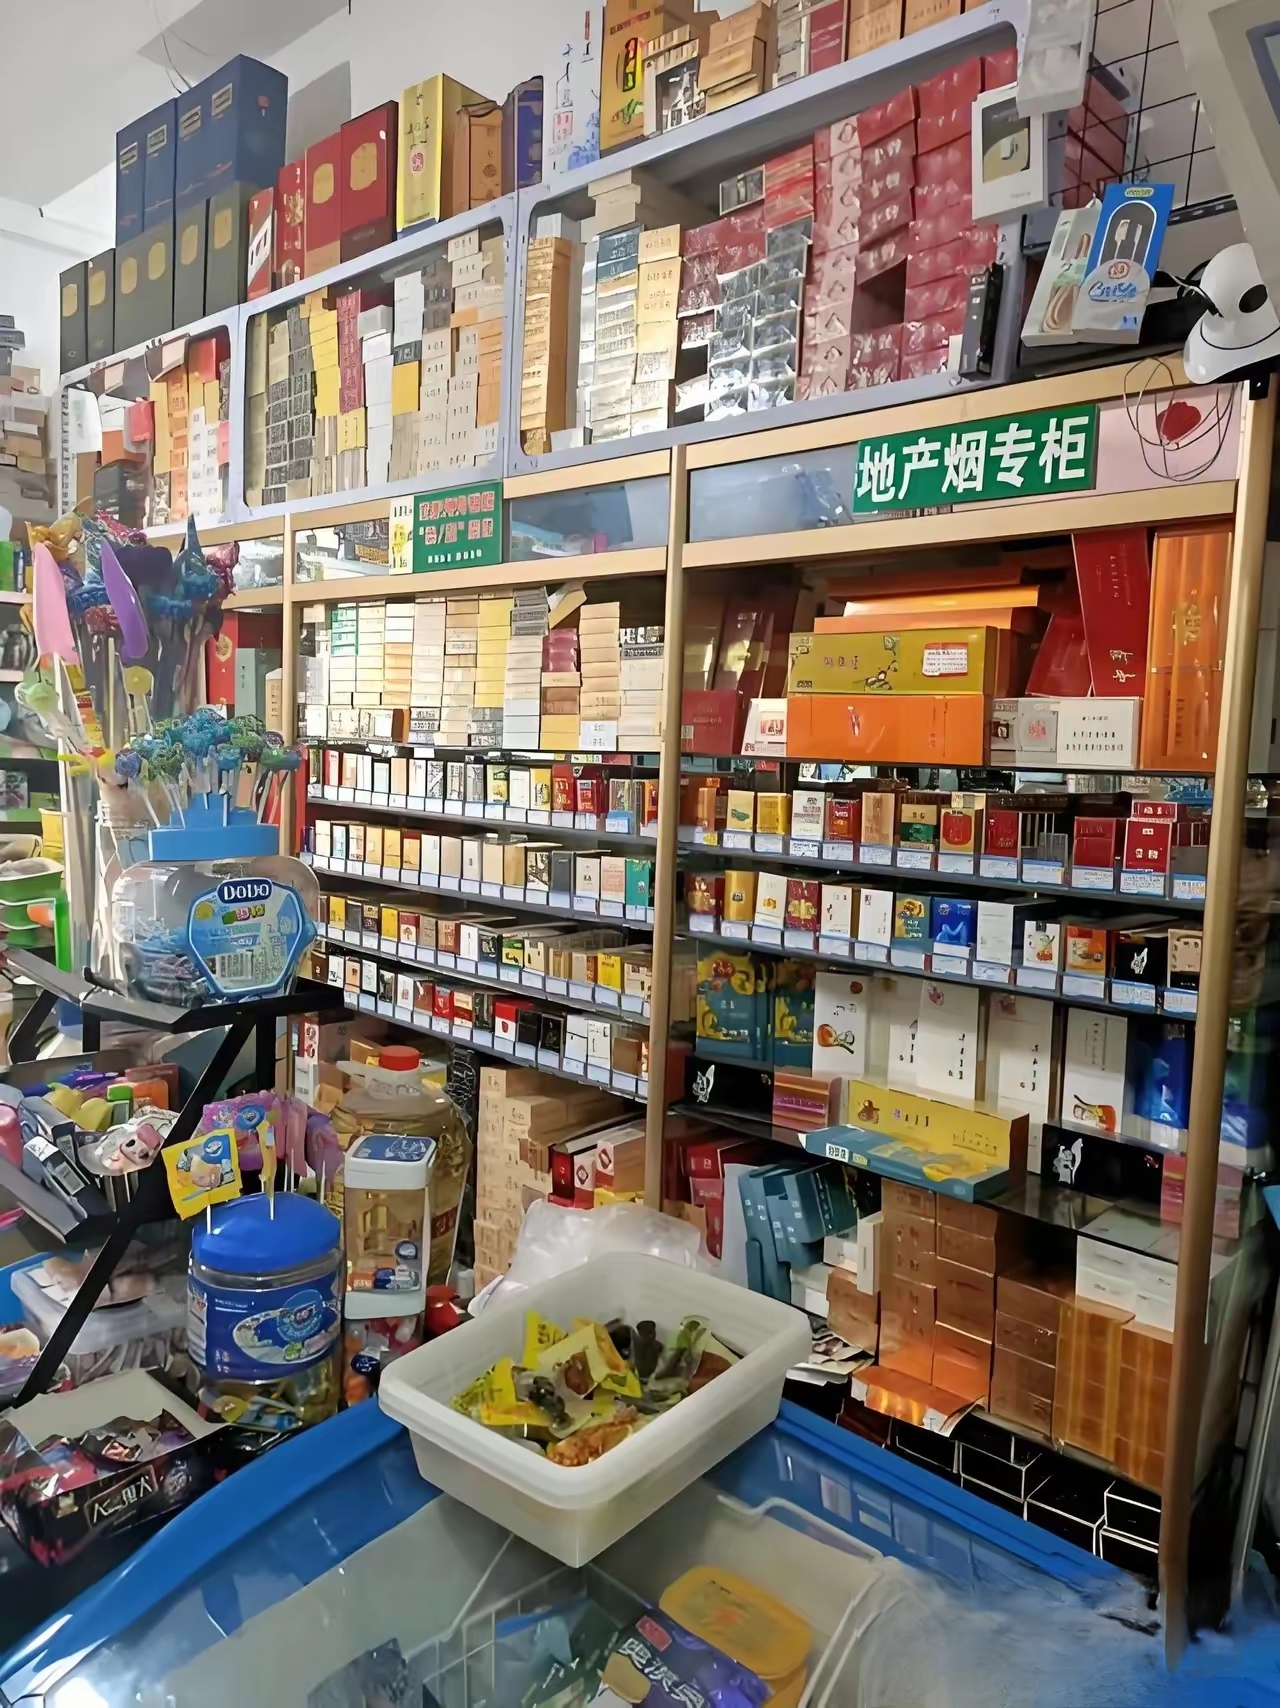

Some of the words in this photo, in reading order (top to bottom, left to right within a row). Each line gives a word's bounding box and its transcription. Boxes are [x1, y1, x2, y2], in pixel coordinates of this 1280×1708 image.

[854, 415, 1090, 503] 地产烟专柜
